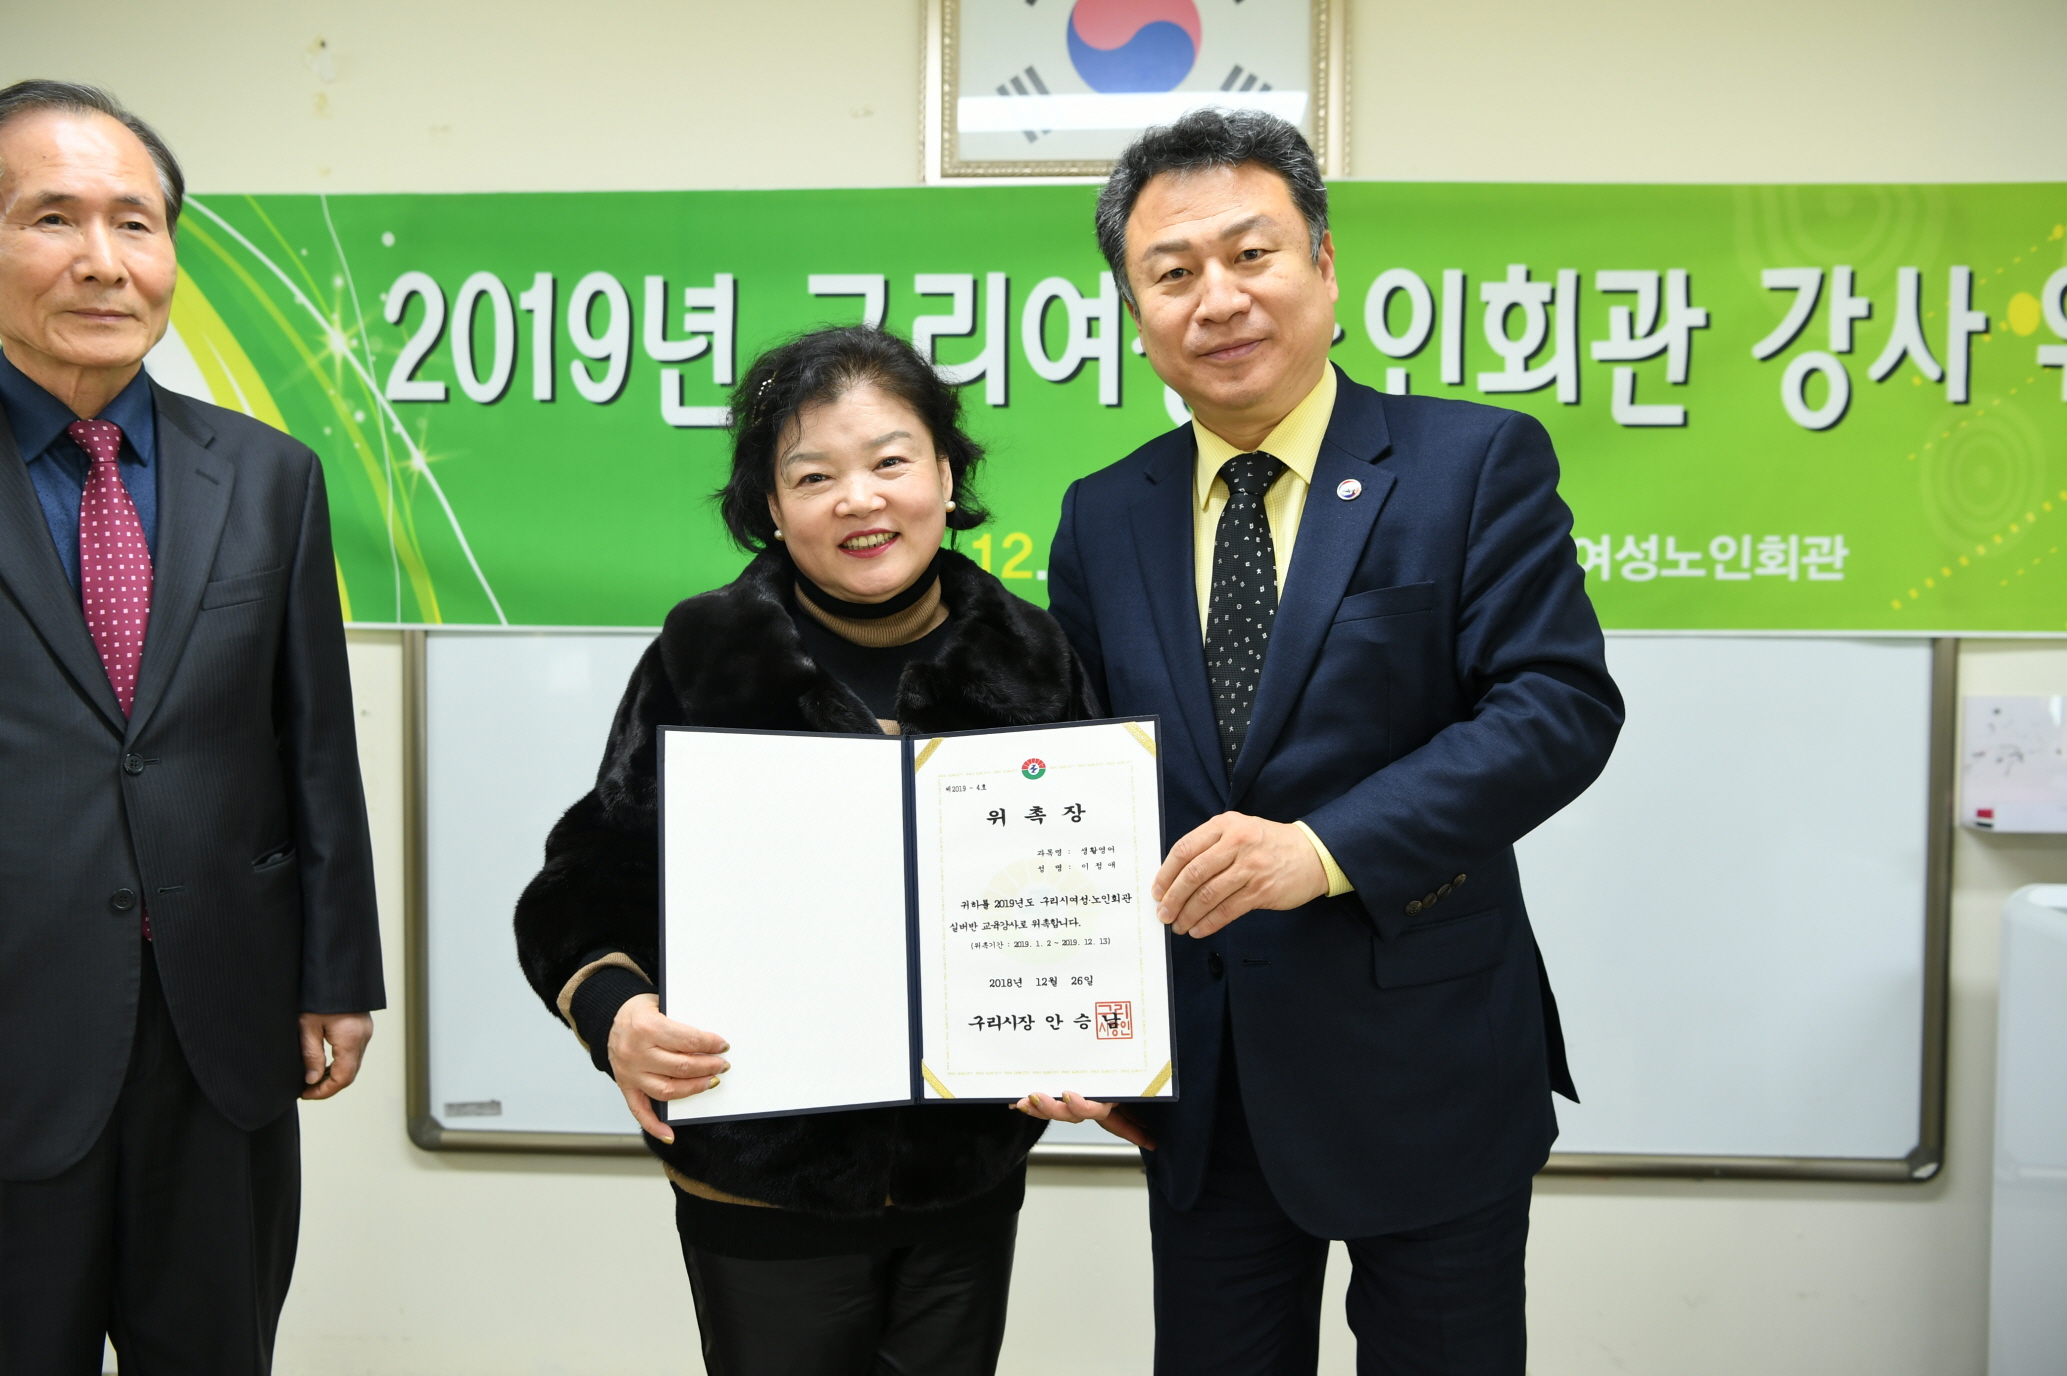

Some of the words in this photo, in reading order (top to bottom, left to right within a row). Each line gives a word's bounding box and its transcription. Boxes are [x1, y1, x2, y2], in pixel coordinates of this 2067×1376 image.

[380, 265, 738, 430] 2019년
[1752, 265, 1988, 430] 강사
[960, 899, 990, 910] 귀하를
[994, 898, 1035, 908] 2019년도
[950, 921, 978, 933] 실버반
[982, 920, 1028, 931] 교육강사로
[1031, 917, 1081, 929] 위촉합니다.
[989, 977, 1022, 988] 2018년
[1036, 976, 1057, 987] 12월
[1071, 975, 1093, 986] 26일
[968, 1014, 1035, 1032] 구리시장
